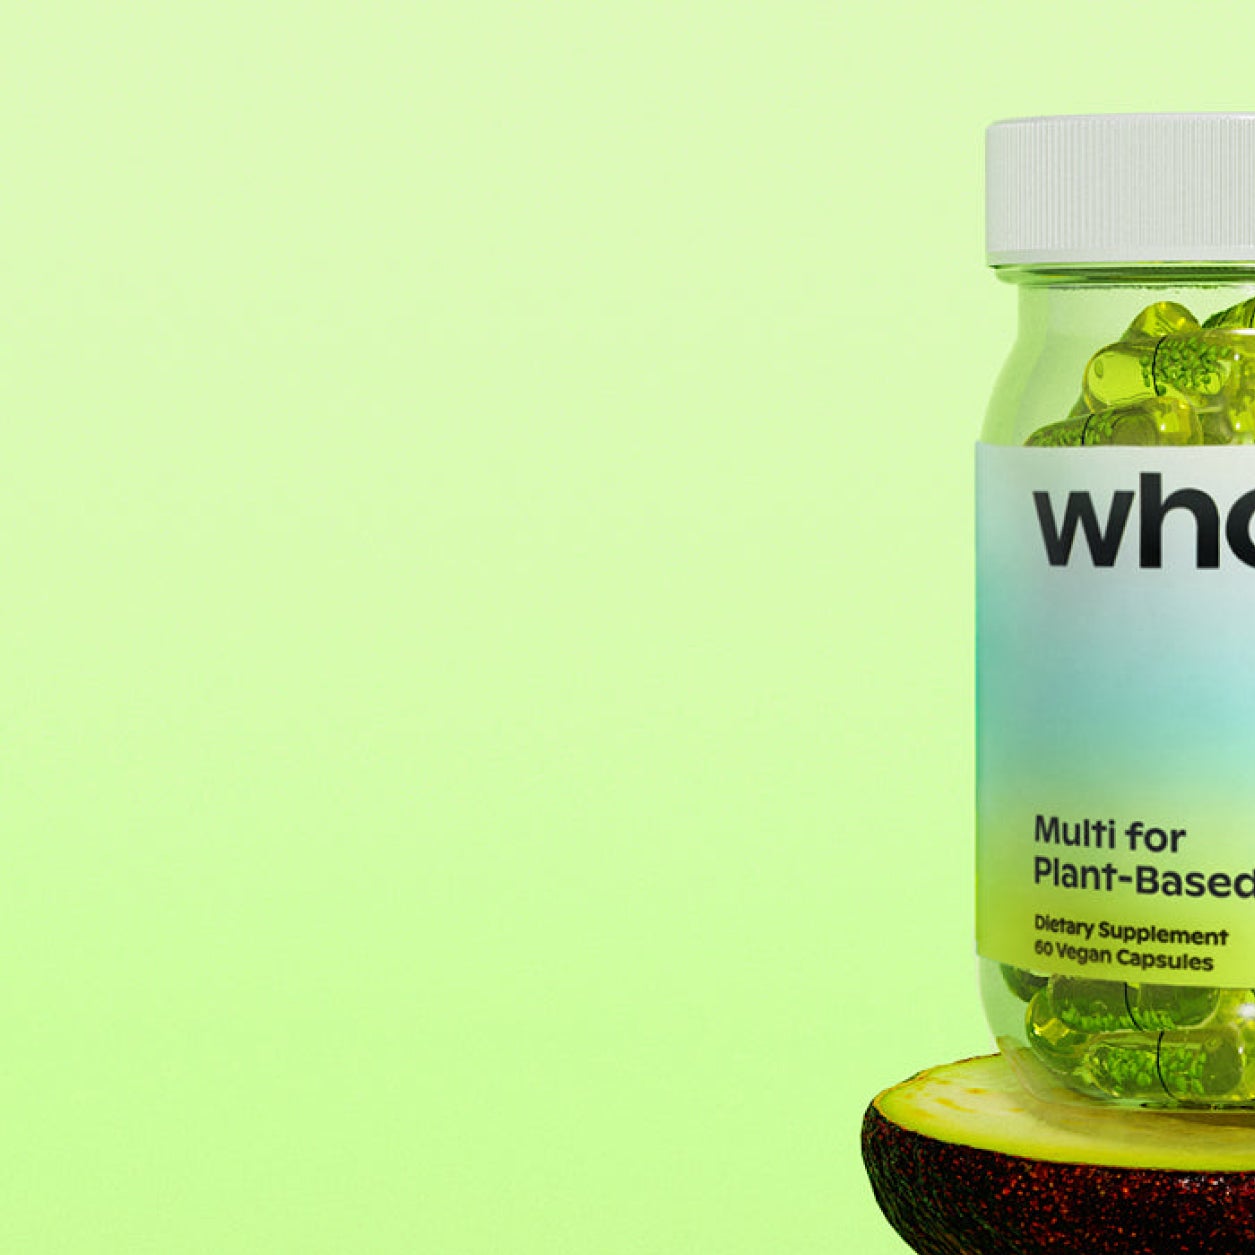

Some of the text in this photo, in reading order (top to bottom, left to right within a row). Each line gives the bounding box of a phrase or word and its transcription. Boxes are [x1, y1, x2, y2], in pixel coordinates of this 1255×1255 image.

[1035, 815, 1186, 853] Multi for
[1035, 914, 1229, 945] Dietary Supplement
[1035, 940, 1213, 971] 60 Vegan Capsules
